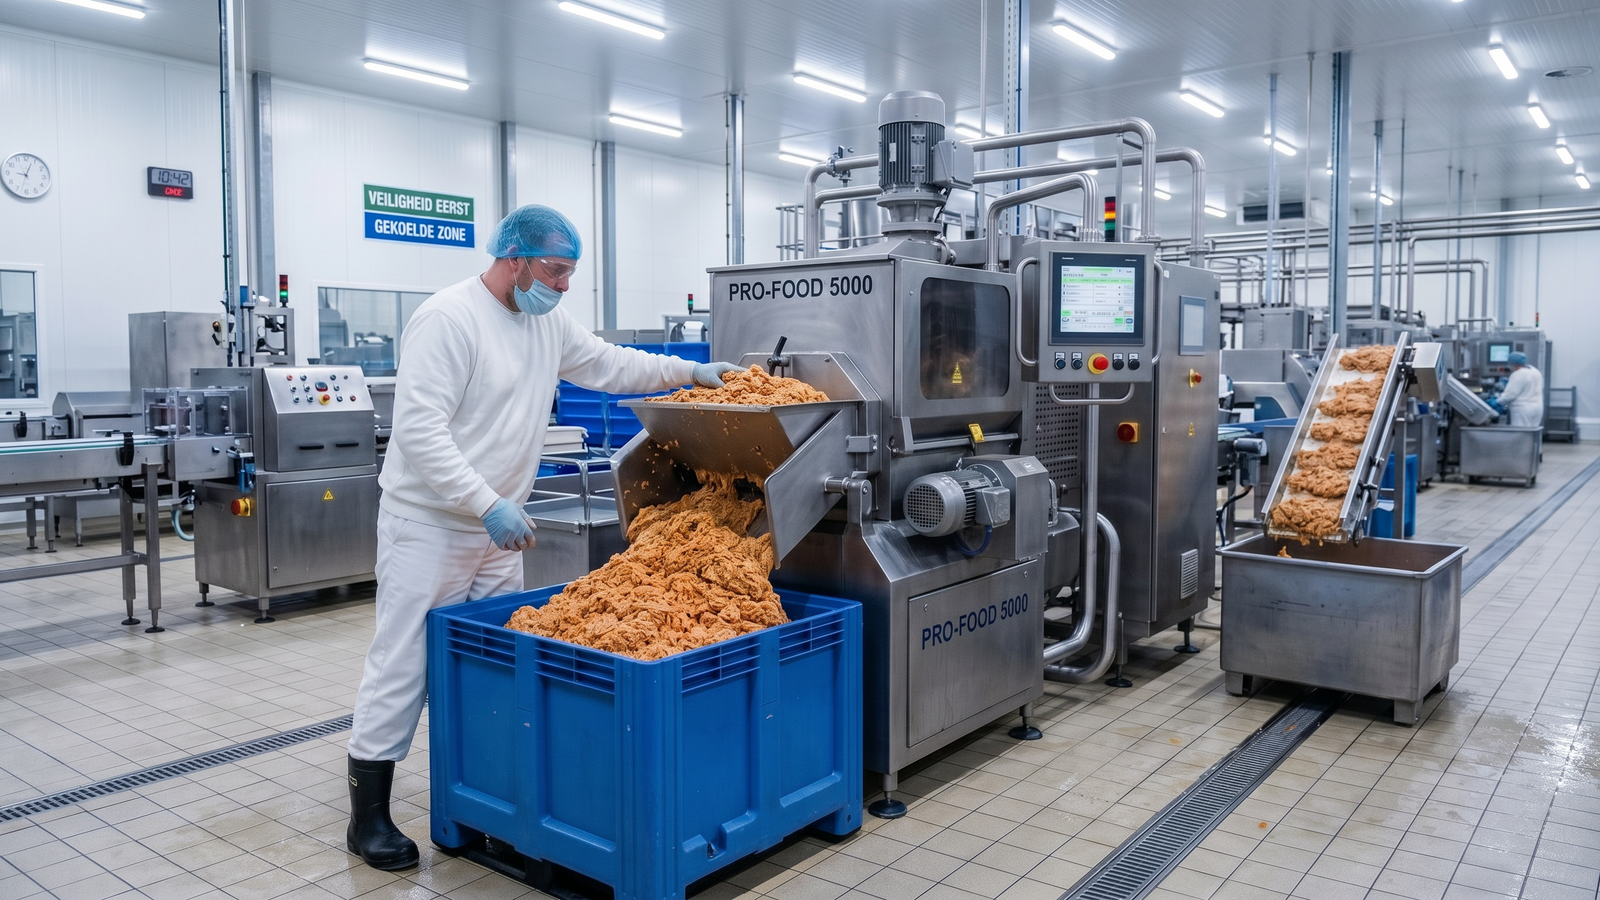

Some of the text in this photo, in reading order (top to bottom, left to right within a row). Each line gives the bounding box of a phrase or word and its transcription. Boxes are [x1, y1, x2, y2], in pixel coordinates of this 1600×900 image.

[158, 170, 189, 186] 10:42
[368, 190, 470, 216] VEILIGHEID EERST
[374, 219, 466, 242] GEKOELDE ZONE
[729, 275, 873, 301] PRO-FOOD 5000
[922, 593, 1028, 650] PRO-FOOD 5000
